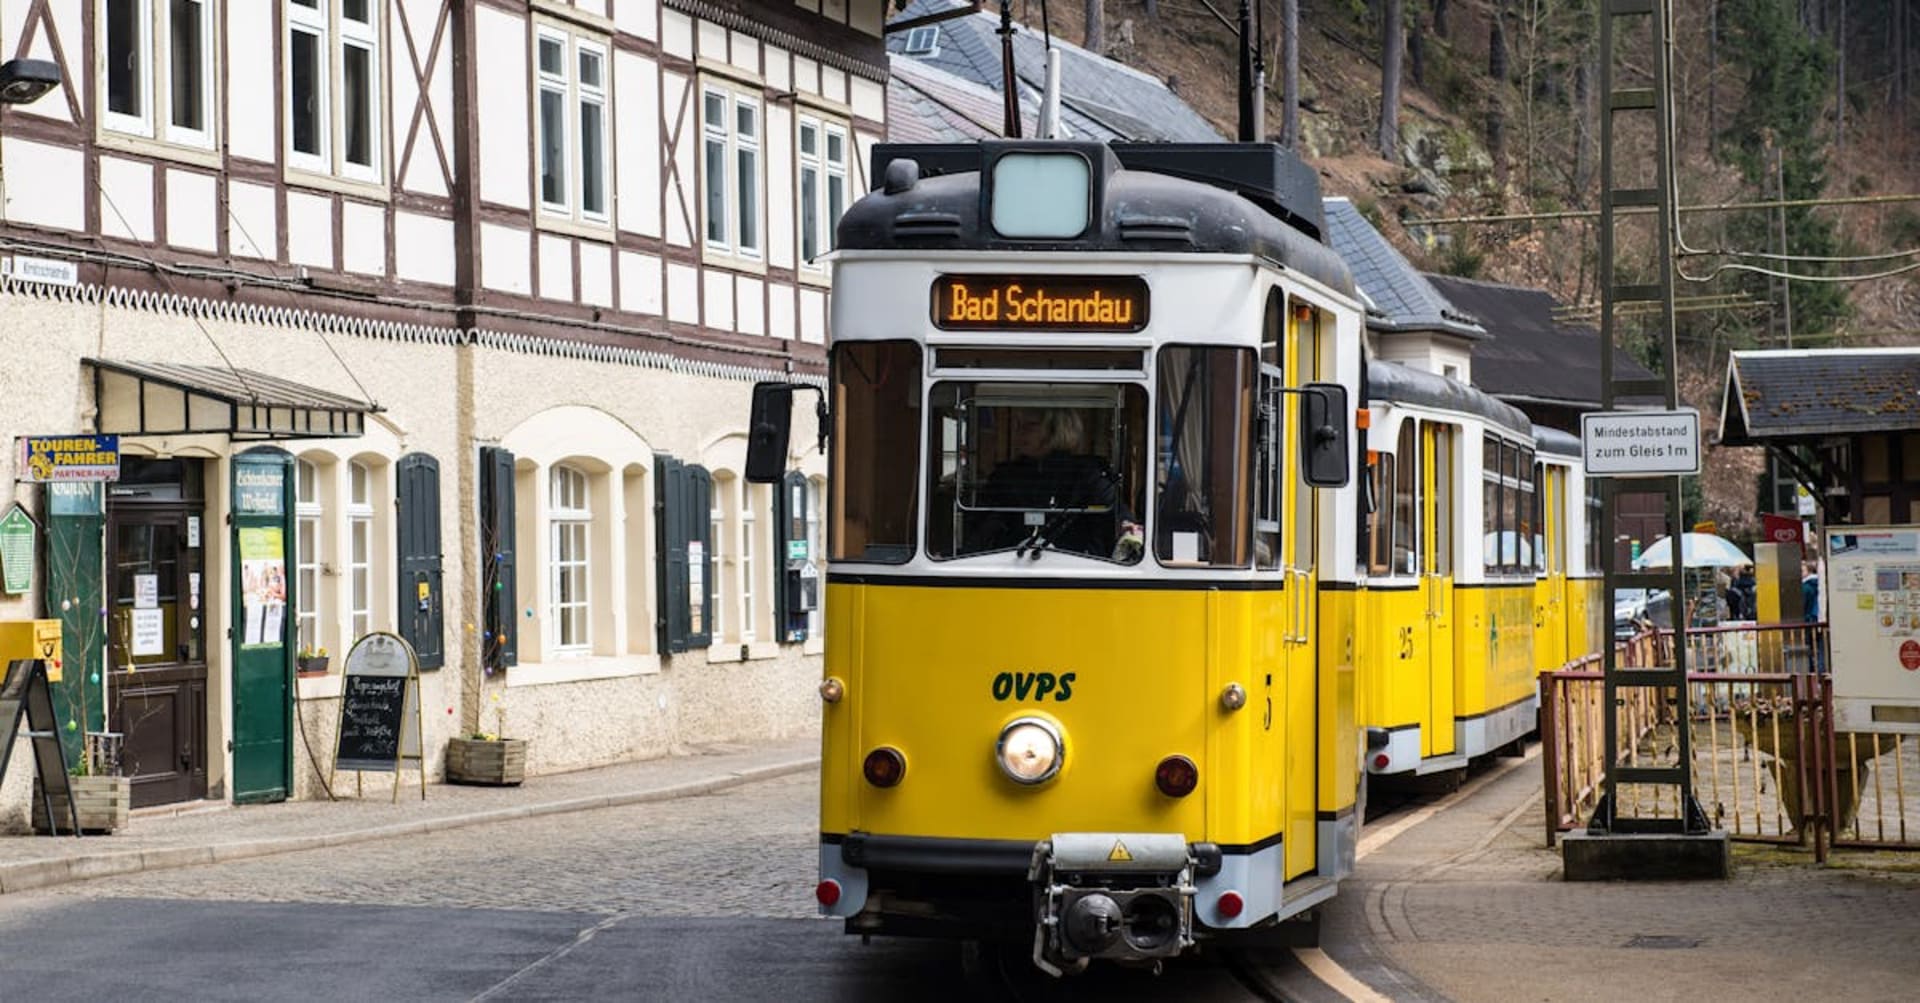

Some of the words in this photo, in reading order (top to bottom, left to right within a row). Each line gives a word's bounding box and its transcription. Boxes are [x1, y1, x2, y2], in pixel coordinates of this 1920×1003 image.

[950, 284, 998, 321] Bad
[1006, 284, 1131, 323] Schandau
[1594, 426, 1687, 438] Mindestabstand
[30, 438, 101, 452] TOUREN-
[1595, 448, 1625, 458] zum
[1629, 444, 1664, 458] Gleis
[54, 452, 117, 465] FAHRER
[54, 469, 118, 478] PARTNER-HAUS
[1399, 626, 1414, 660] 25
[992, 671, 1076, 701] OVPS
